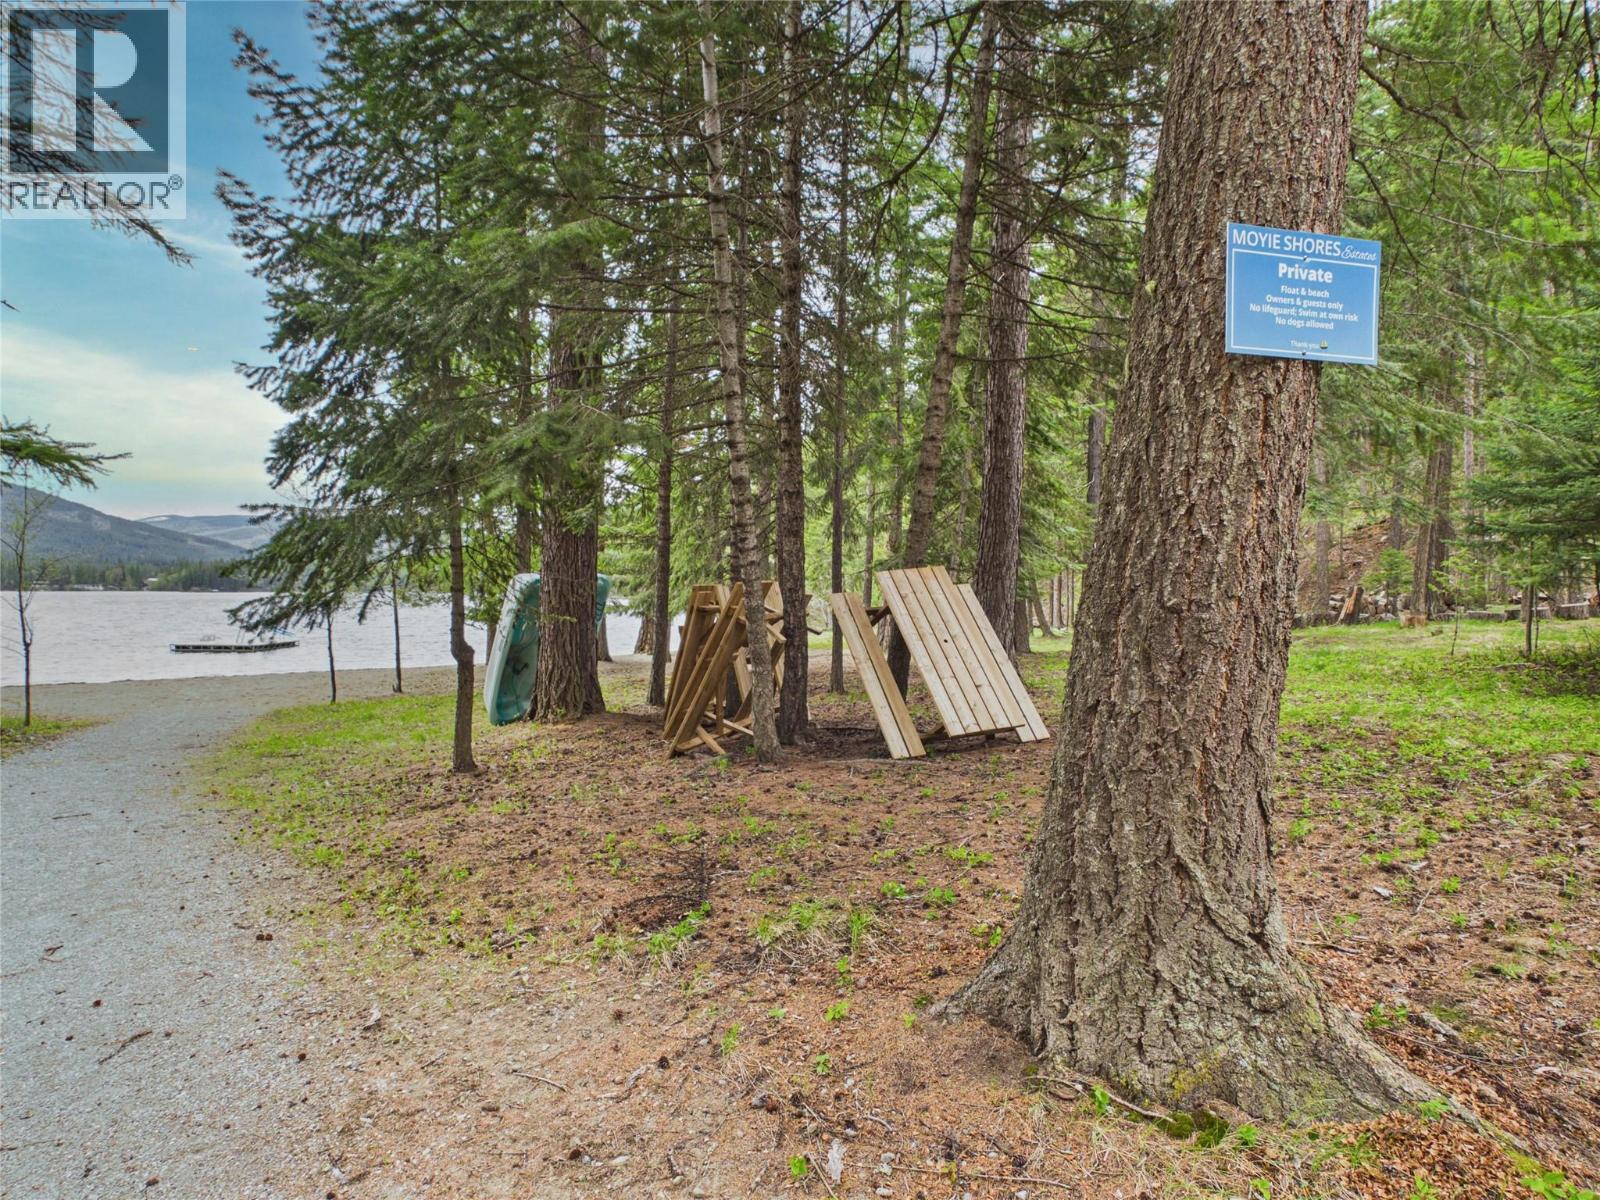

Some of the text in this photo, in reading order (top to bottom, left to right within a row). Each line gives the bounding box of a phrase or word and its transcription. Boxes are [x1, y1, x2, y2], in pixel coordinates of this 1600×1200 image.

[1232, 229, 1377, 261] MOYIE SHORES Estates
[1278, 263, 1334, 284] Private
[1280, 285, 1330, 298] Float & beach
[1266, 294, 1344, 312] Owners & guests only
[1249, 303, 1261, 313] No
[1298, 308, 1319, 318] Swim
[1319, 311, 1328, 319] at
[1328, 312, 1344, 321] own
[1344, 313, 1359, 322] risk
[1275, 316, 1335, 330] No dogs allowed
